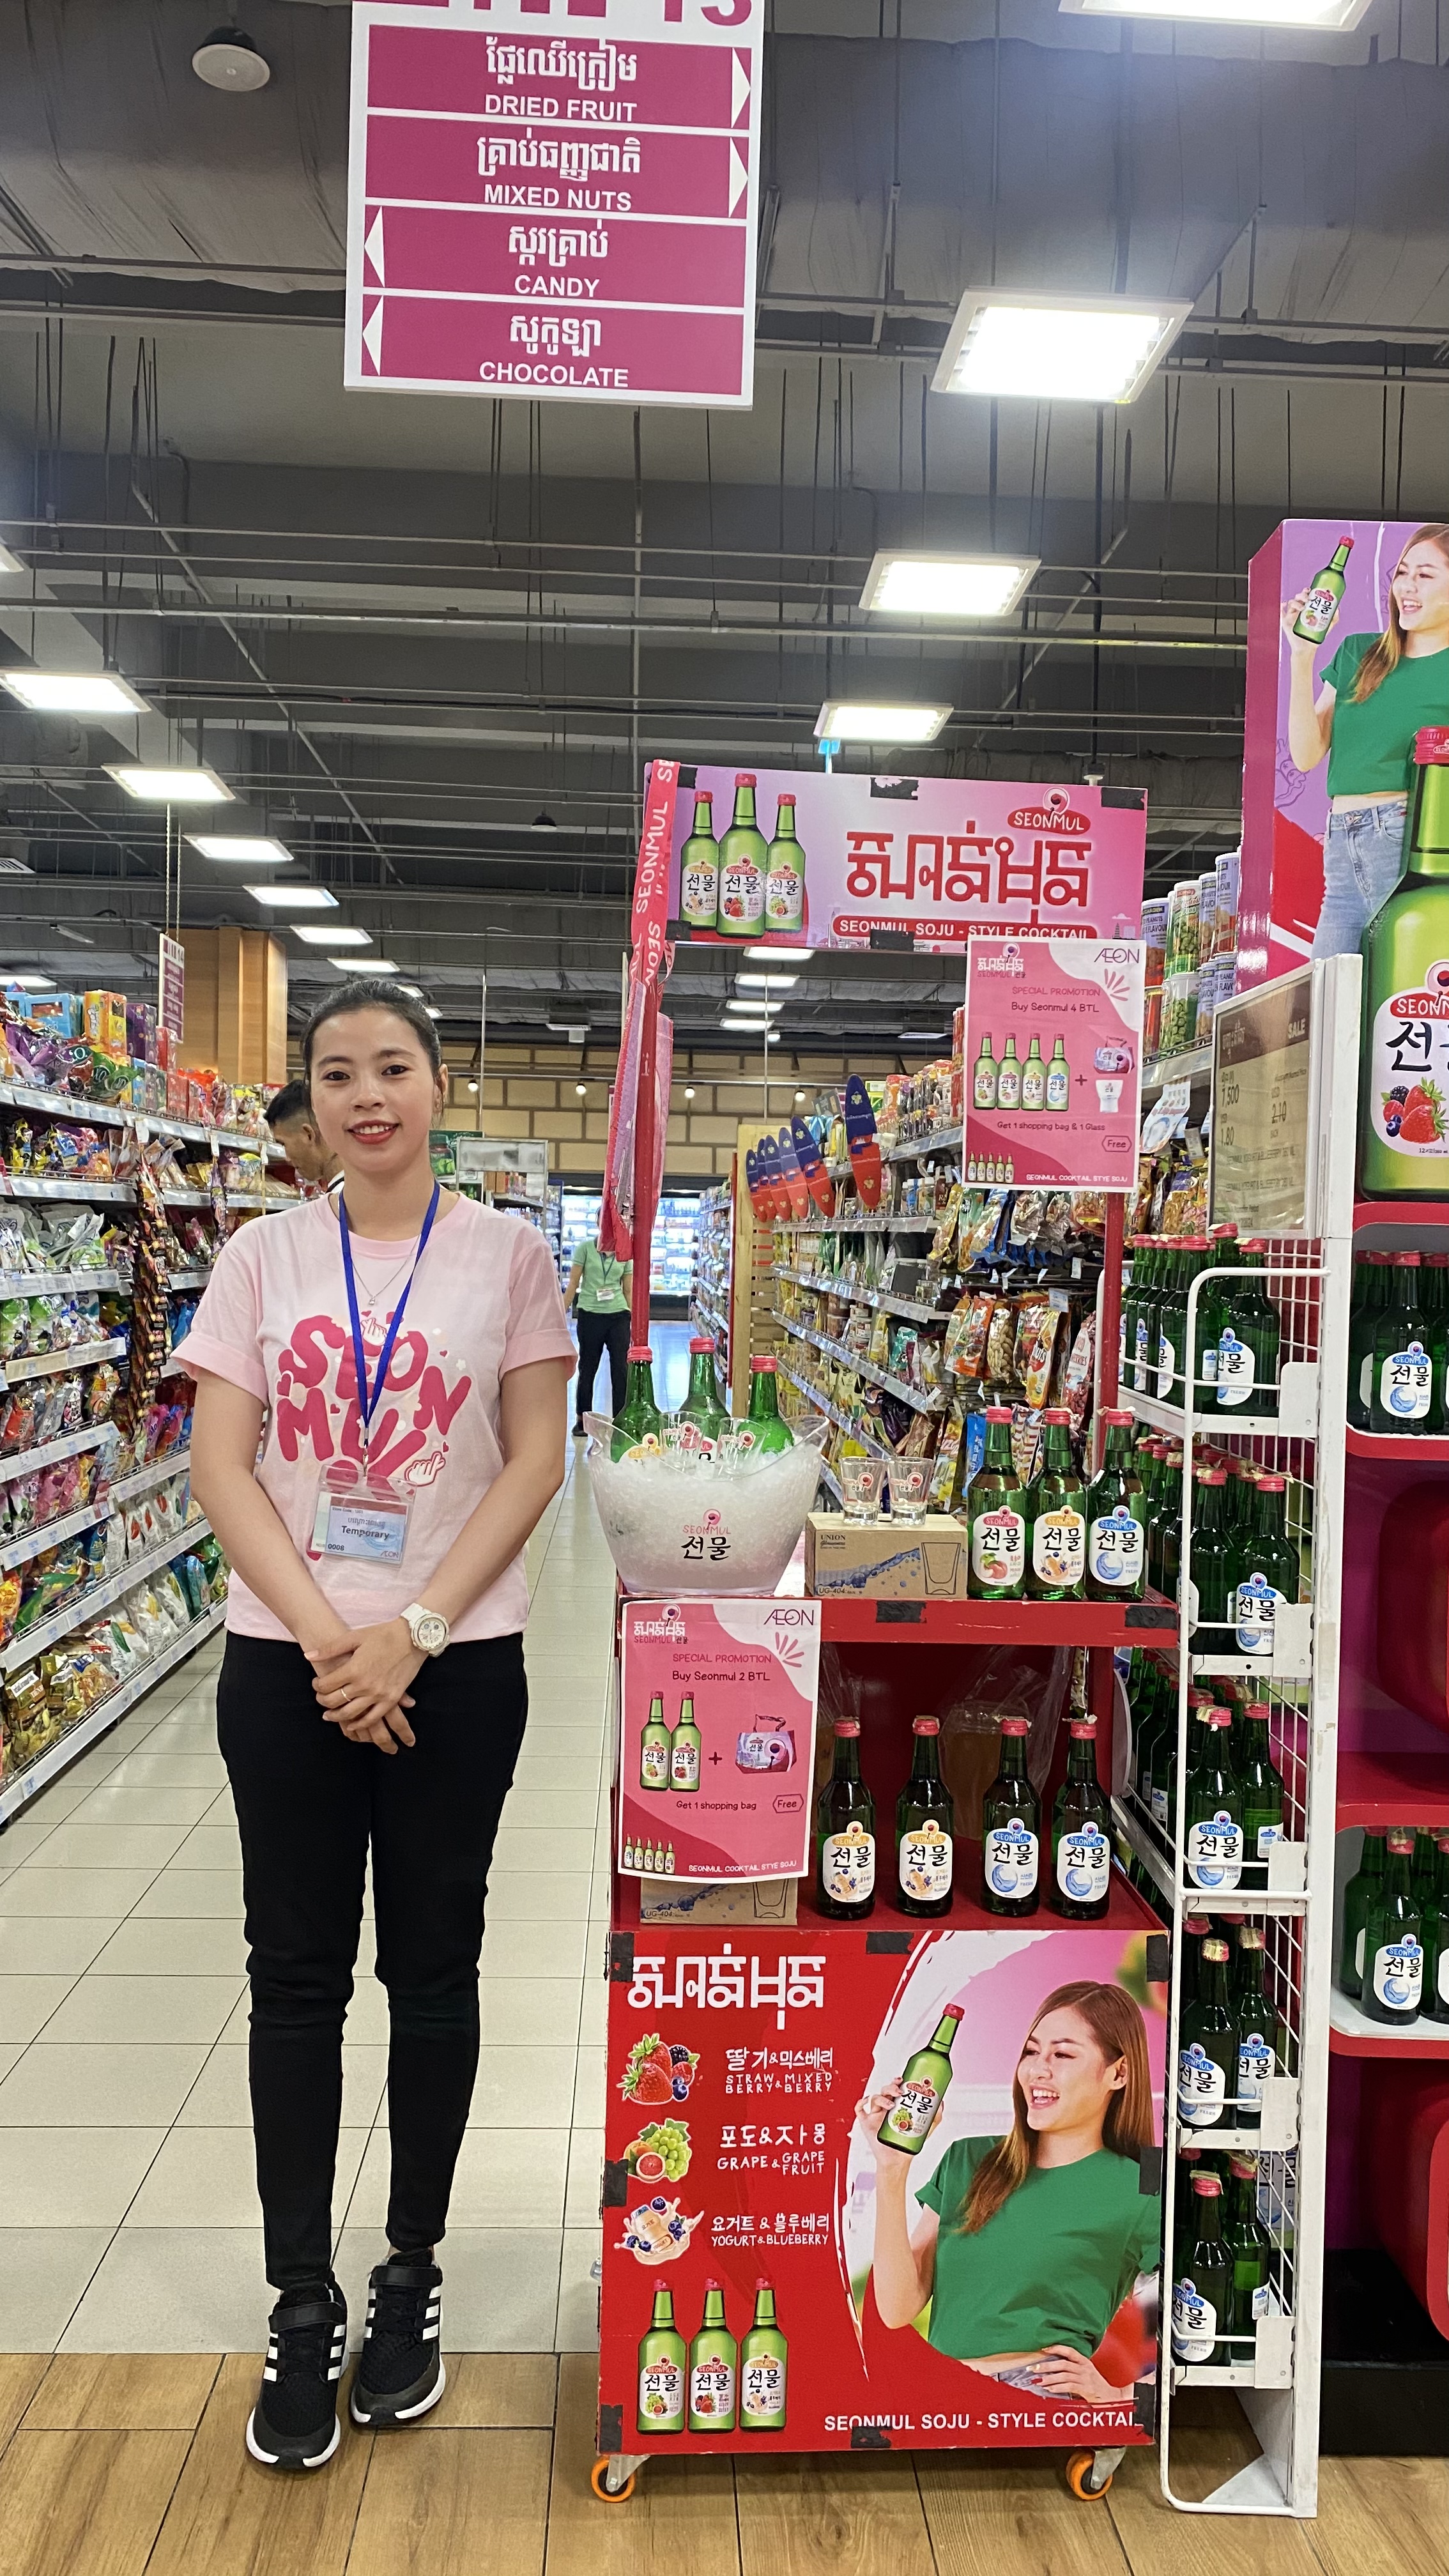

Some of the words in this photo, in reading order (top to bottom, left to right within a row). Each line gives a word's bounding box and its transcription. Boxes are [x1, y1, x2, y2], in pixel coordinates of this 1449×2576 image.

[485, 95, 558, 116] DRIED
[567, 100, 637, 121] FRUIT
[484, 184, 559, 206] MIXED
[568, 190, 631, 211] NUTS
[514, 275, 599, 297] CANDY
[511, 315, 601, 356] សូកូឡា
[479, 362, 628, 387] CHOCOLATE
[1014, 811, 1084, 831] SEONMUL
[636, 801, 668, 914] SEONMUL
[916, 923, 954, 937] SOJU
[969, 924, 1015, 937] STYLE
[1012, 986, 1048, 995] SPECIAL
[1050, 988, 1100, 996] PROMOTION
[1011, 1002, 1028, 1012] Buy
[1031, 1002, 1068, 1011] Seonmul
[1287, 1018, 1306, 1039] SALE
[1222, 1084, 1239, 1108] 7,500
[1271, 1101, 1287, 1124] 2.10
[1019, 1122, 1053, 1131] shopping
[1055, 1123, 1070, 1131] bag
[1221, 1126, 1234, 1146] 1.80
[1107, 1139, 1126, 1148] Free
[986, 1517, 1016, 1526] SEONMUL
[1048, 1517, 1078, 1526] SEONMUL
[1100, 1521, 1135, 1530] SEONMUL
[342, 1526, 389, 1540] Temporary
[682, 1524, 731, 1535] SEONMUL
[1240, 1586, 1272, 1598] SEONMUL
[634, 1636, 671, 1644] SEONMUL
[673, 1653, 712, 1662] SPECIAL
[715, 1653, 772, 1663] PROMOTION
[672, 1670, 691, 1682] Buy
[694, 1671, 736, 1681] Seonmul
[739, 1672, 745, 1681] 2
[748, 1672, 770, 1681] BTL
[676, 1800, 692, 1809] Get
[701, 1801, 739, 1811] shopping
[740, 1802, 756, 1811] bag
[778, 1800, 797, 1808] Free
[1201, 1825, 1236, 1834] SEONMUL
[910, 1835, 944, 1843] SEONMUL
[995, 1832, 1029, 1843] SEONMUL
[1070, 1836, 1103, 1846] SEONMUL
[689, 1864, 723, 1873] SEONMUL
[780, 1860, 797, 1869] SOJU
[726, 2073, 774, 2084] STRAW
[785, 2073, 832, 2083] MIXED
[726, 2083, 773, 2094] BERRY
[785, 2082, 831, 2094] BERRY
[717, 2156, 768, 2171] GRAPE
[772, 2159, 780, 2168] &
[782, 2150, 825, 2163] GRAPE
[783, 2163, 824, 2175] FRUIT
[711, 2216, 755, 2232] 요거트
[760, 2218, 770, 2229] &
[774, 2212, 829, 2233] 블루베리
[824, 2414, 915, 2431] SEONMUL
[921, 2414, 969, 2430] SOJU
[987, 2412, 1046, 2428] STYLE
[1052, 2411, 1144, 2427] COCKTAI
